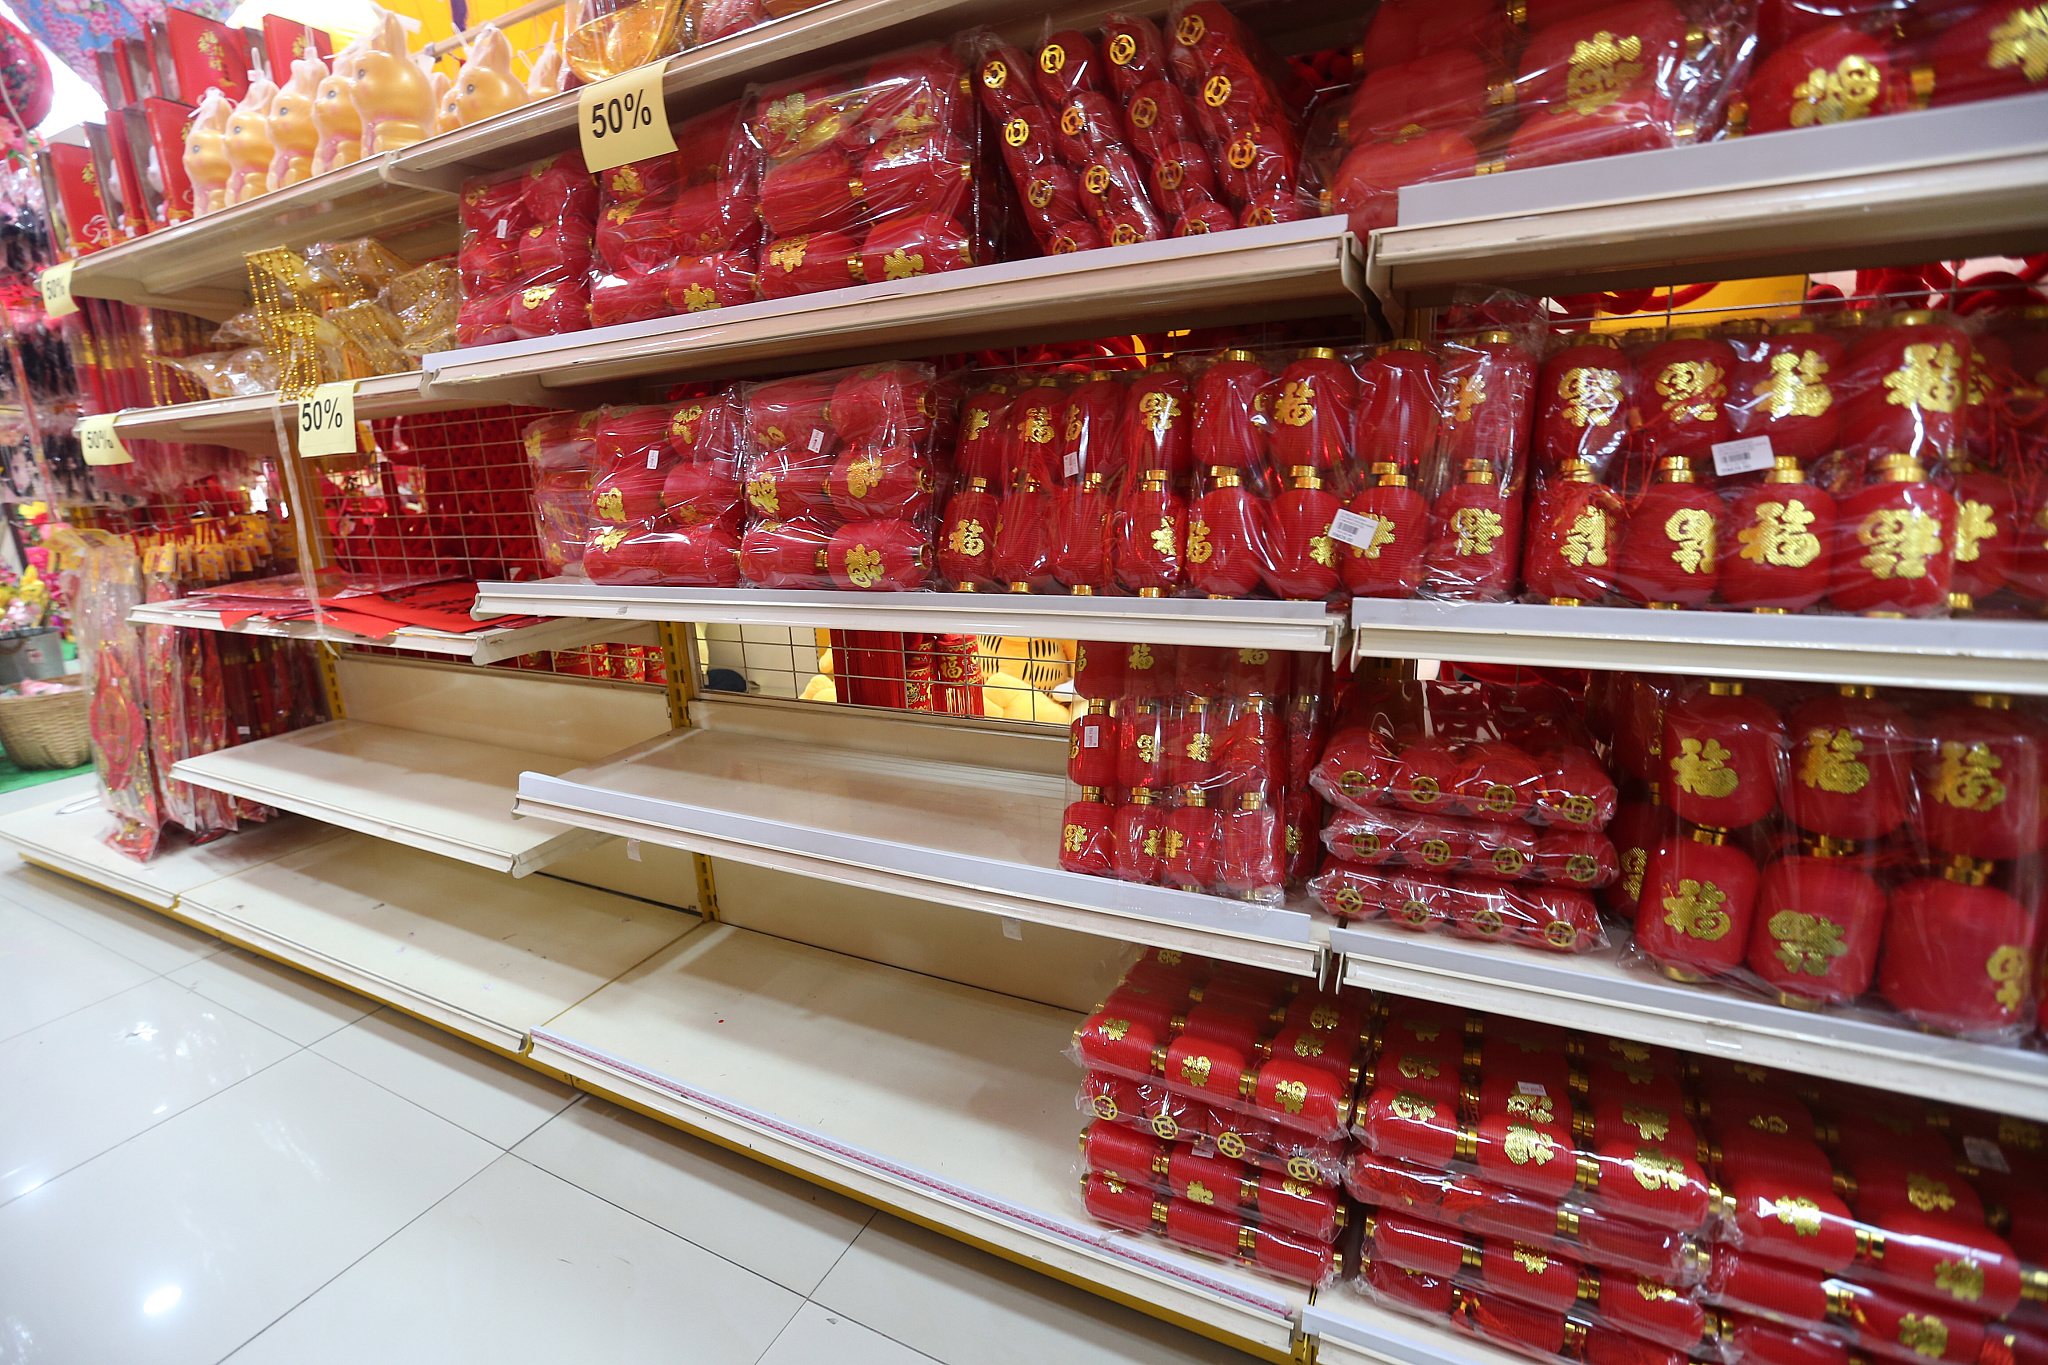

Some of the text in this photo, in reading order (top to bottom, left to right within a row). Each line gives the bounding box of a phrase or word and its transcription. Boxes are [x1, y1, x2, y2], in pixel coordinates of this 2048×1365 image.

[591, 89, 652, 139] 50%
[46, 274, 66, 301] 50%
[1753, 350, 1833, 418] 福
[1882, 342, 1962, 414] 福
[302, 397, 343, 432] 50%
[1018, 407, 1054, 443] 福
[1274, 381, 1316, 426] 福
[86, 429, 115, 450] 50%
[949, 519, 985, 556] 福
[1738, 500, 1820, 568] 福
[940, 655, 963, 678] 福
[1129, 643, 1154, 670] 福
[1670, 738, 1738, 798] 福
[1800, 729, 1870, 793] 福
[1932, 741, 2006, 812] 福
[1663, 879, 1731, 941] 福
[1768, 910, 1847, 976] 福
[1181, 1056, 1211, 1087] 福
[1275, 1080, 1308, 1114] 福
[1504, 1121, 1555, 1165] 福
